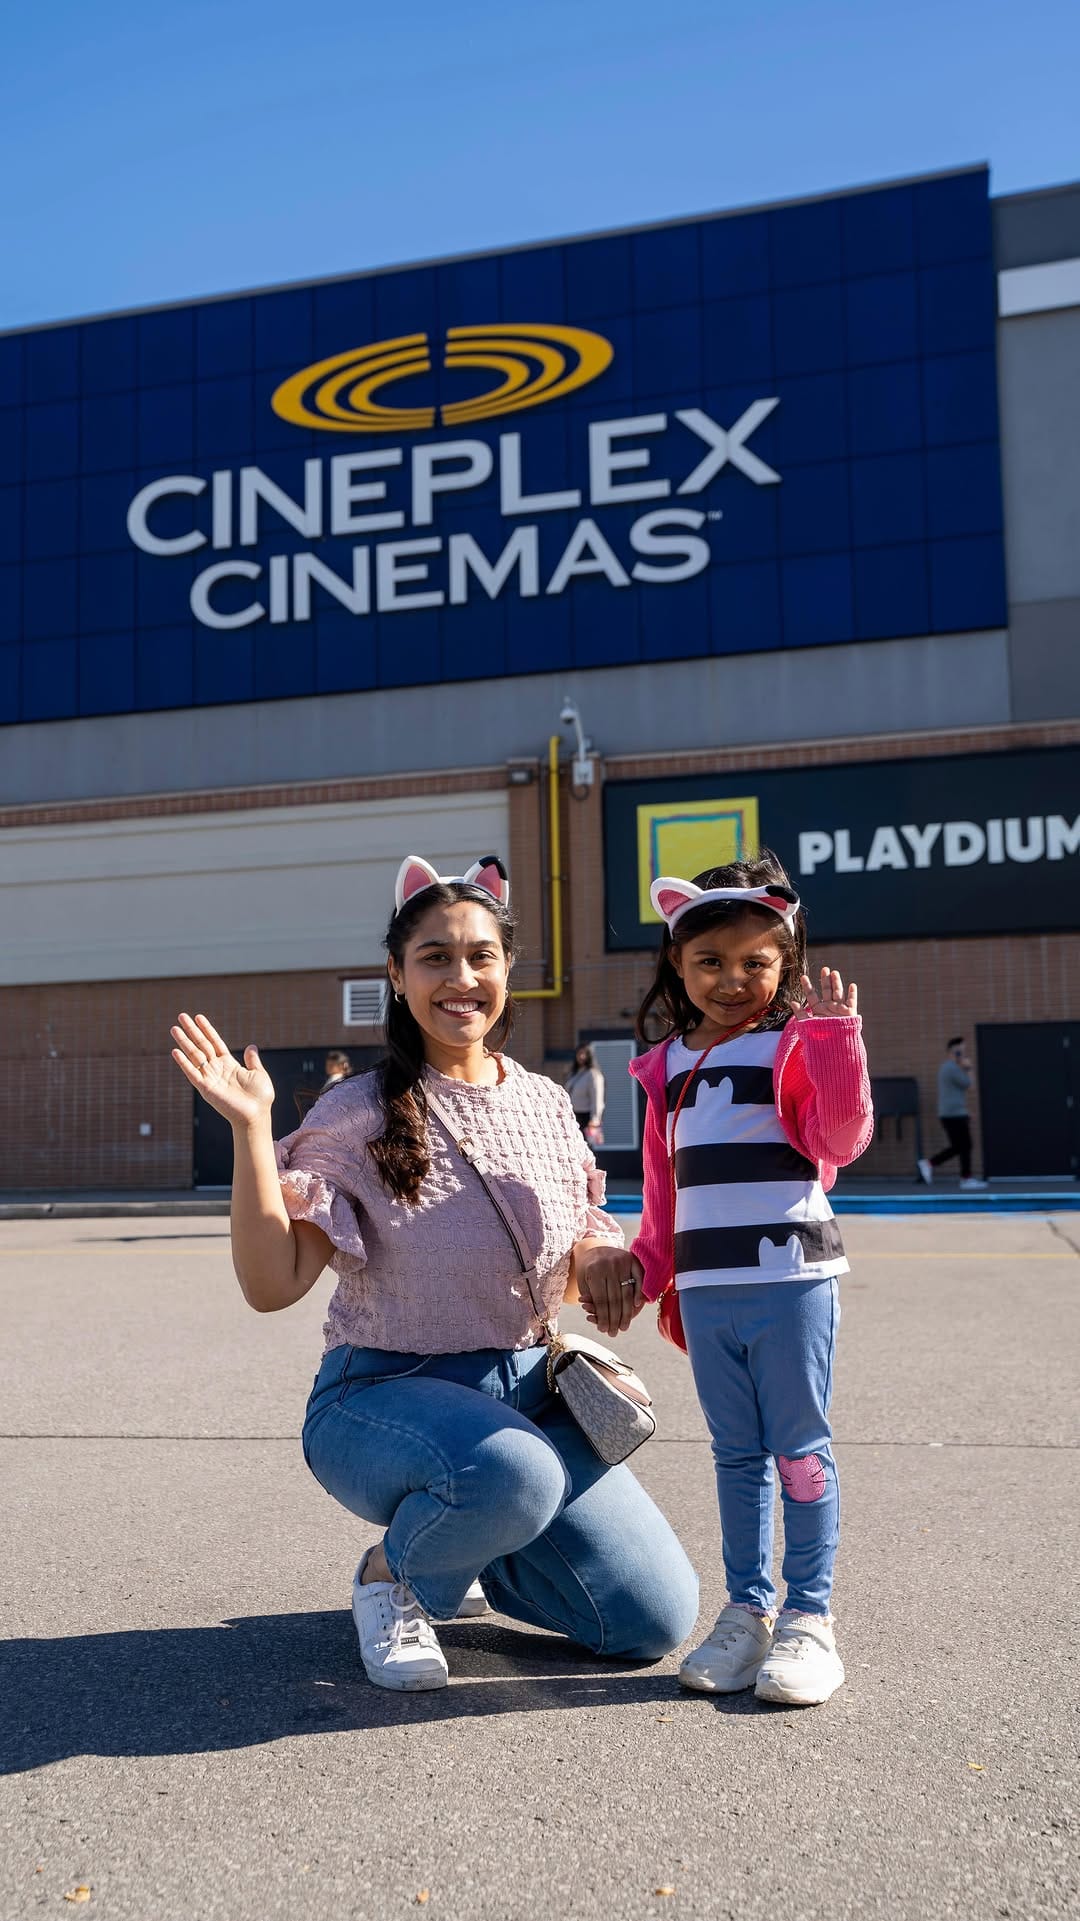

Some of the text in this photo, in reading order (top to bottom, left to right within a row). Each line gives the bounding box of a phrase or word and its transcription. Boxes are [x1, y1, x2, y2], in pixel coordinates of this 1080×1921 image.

[127, 397, 780, 555] CINEPLEX
[190, 508, 710, 629] CINEMAS
[798, 814, 1080, 875] PLAYDIUM
